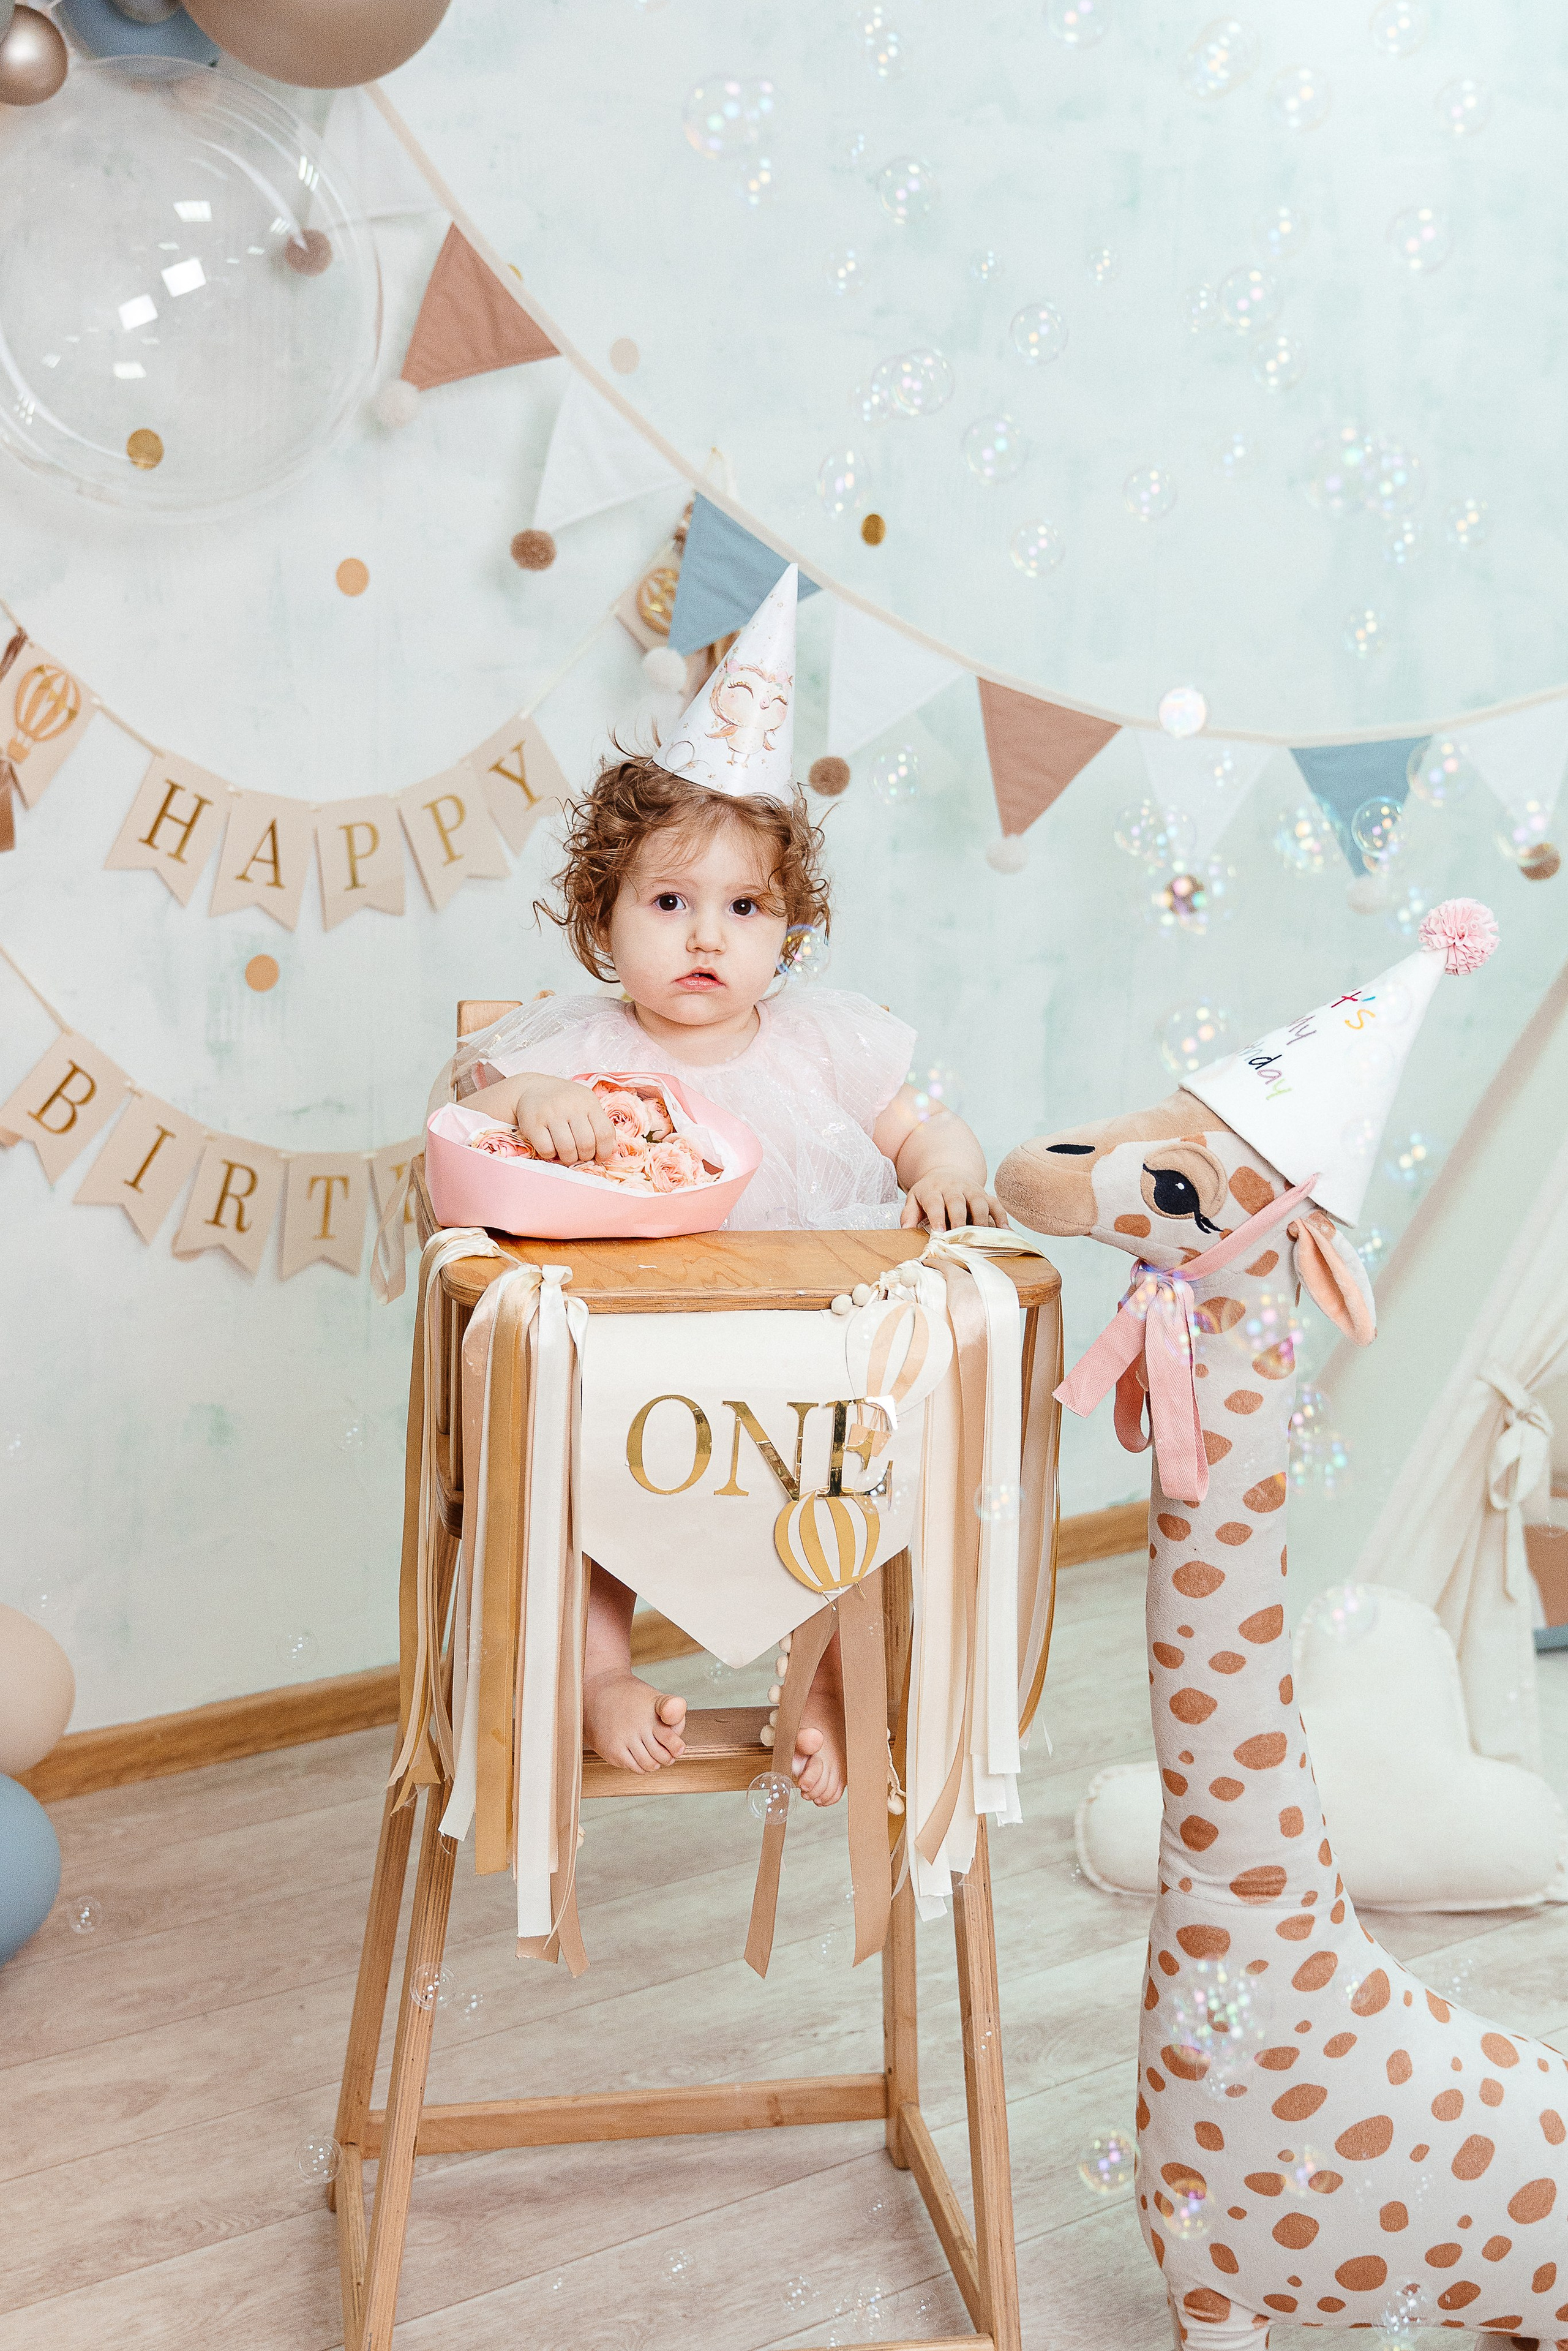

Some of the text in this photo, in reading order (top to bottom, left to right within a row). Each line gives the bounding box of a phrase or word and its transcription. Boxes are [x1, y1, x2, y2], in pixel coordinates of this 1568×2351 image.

[138, 739, 543, 892] HAPPY
[1324, 988, 1376, 1029] t's
[27, 1059, 415, 1241] BIRT
[625, 1394, 893, 1502] ONE
